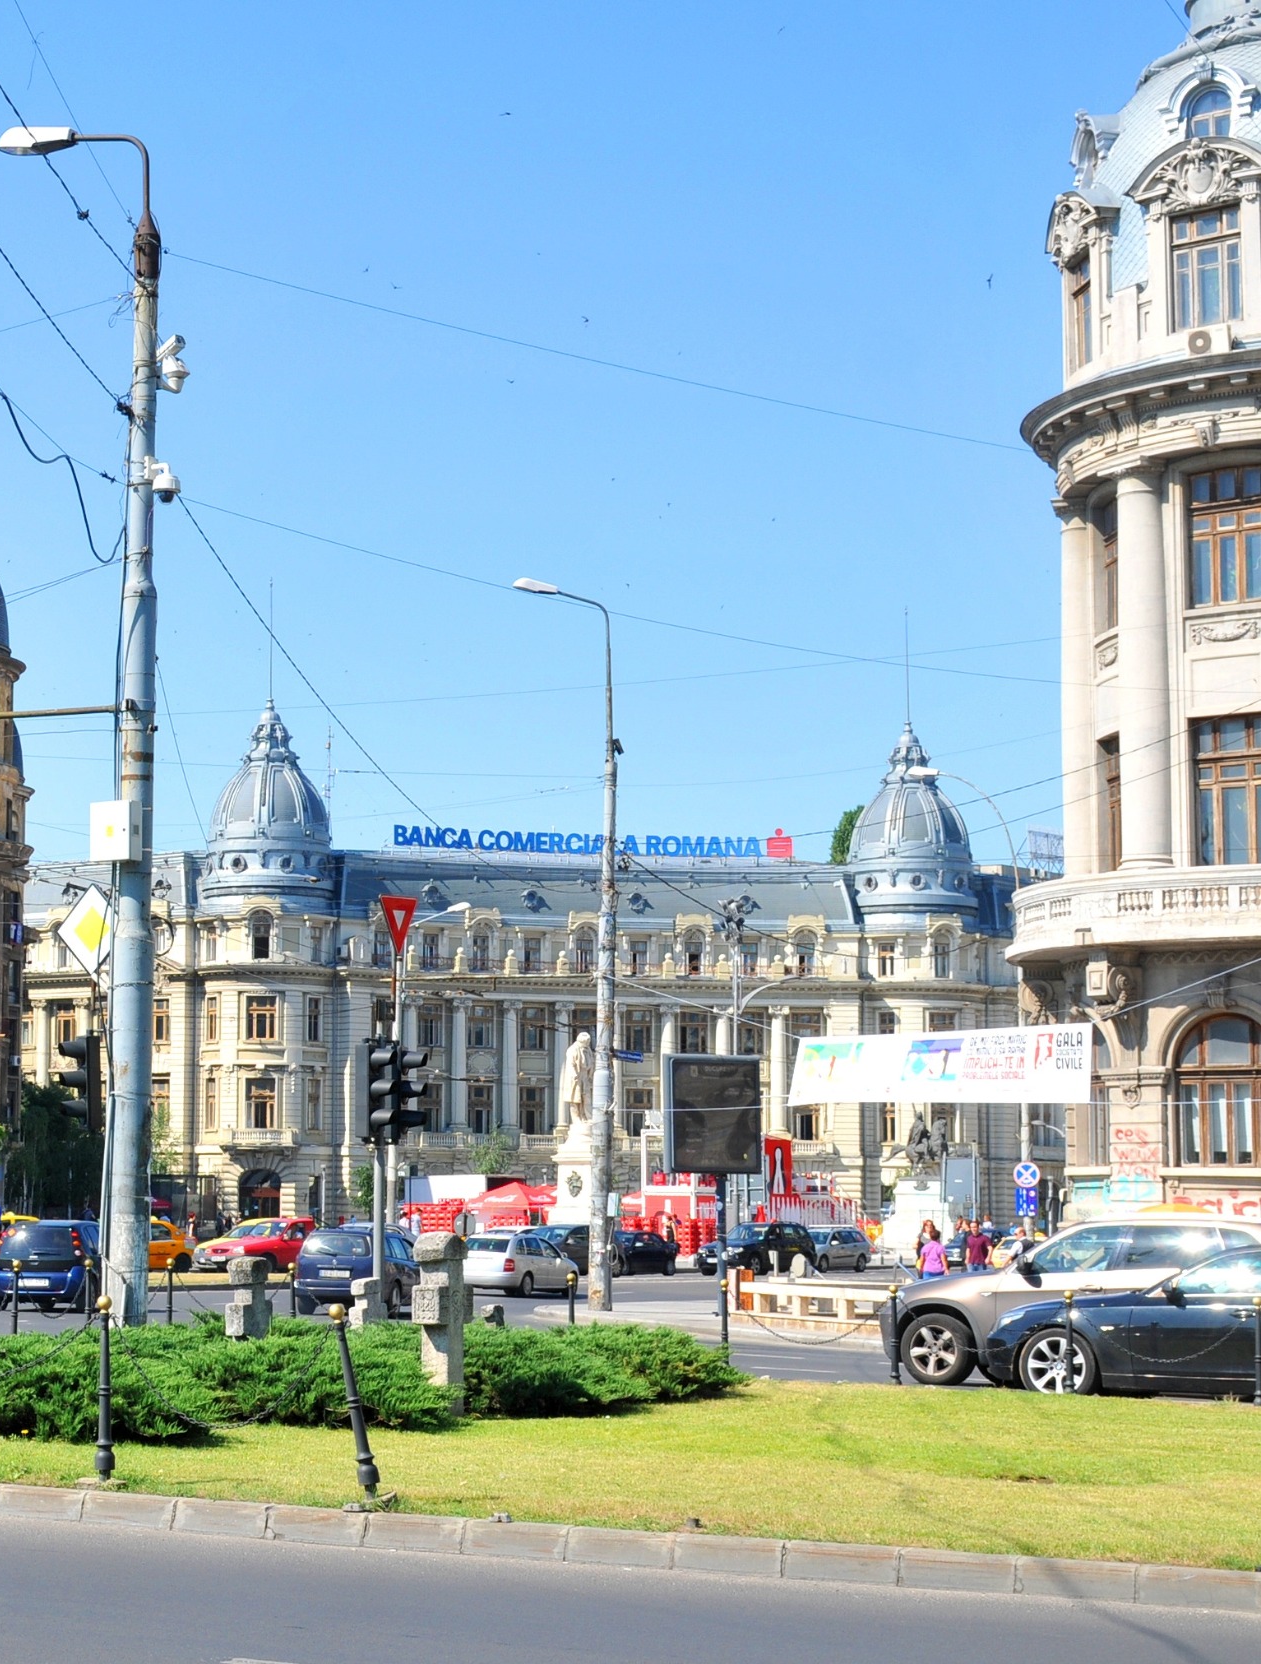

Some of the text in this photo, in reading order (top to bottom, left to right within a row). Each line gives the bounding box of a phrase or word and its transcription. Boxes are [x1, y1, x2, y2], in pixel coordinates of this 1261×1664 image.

[393, 824, 762, 857] BANCA COMERCIAA ROMANA
[1056, 1032, 1083, 1047] GALA
[1056, 1057, 1083, 1070] CIVILE
